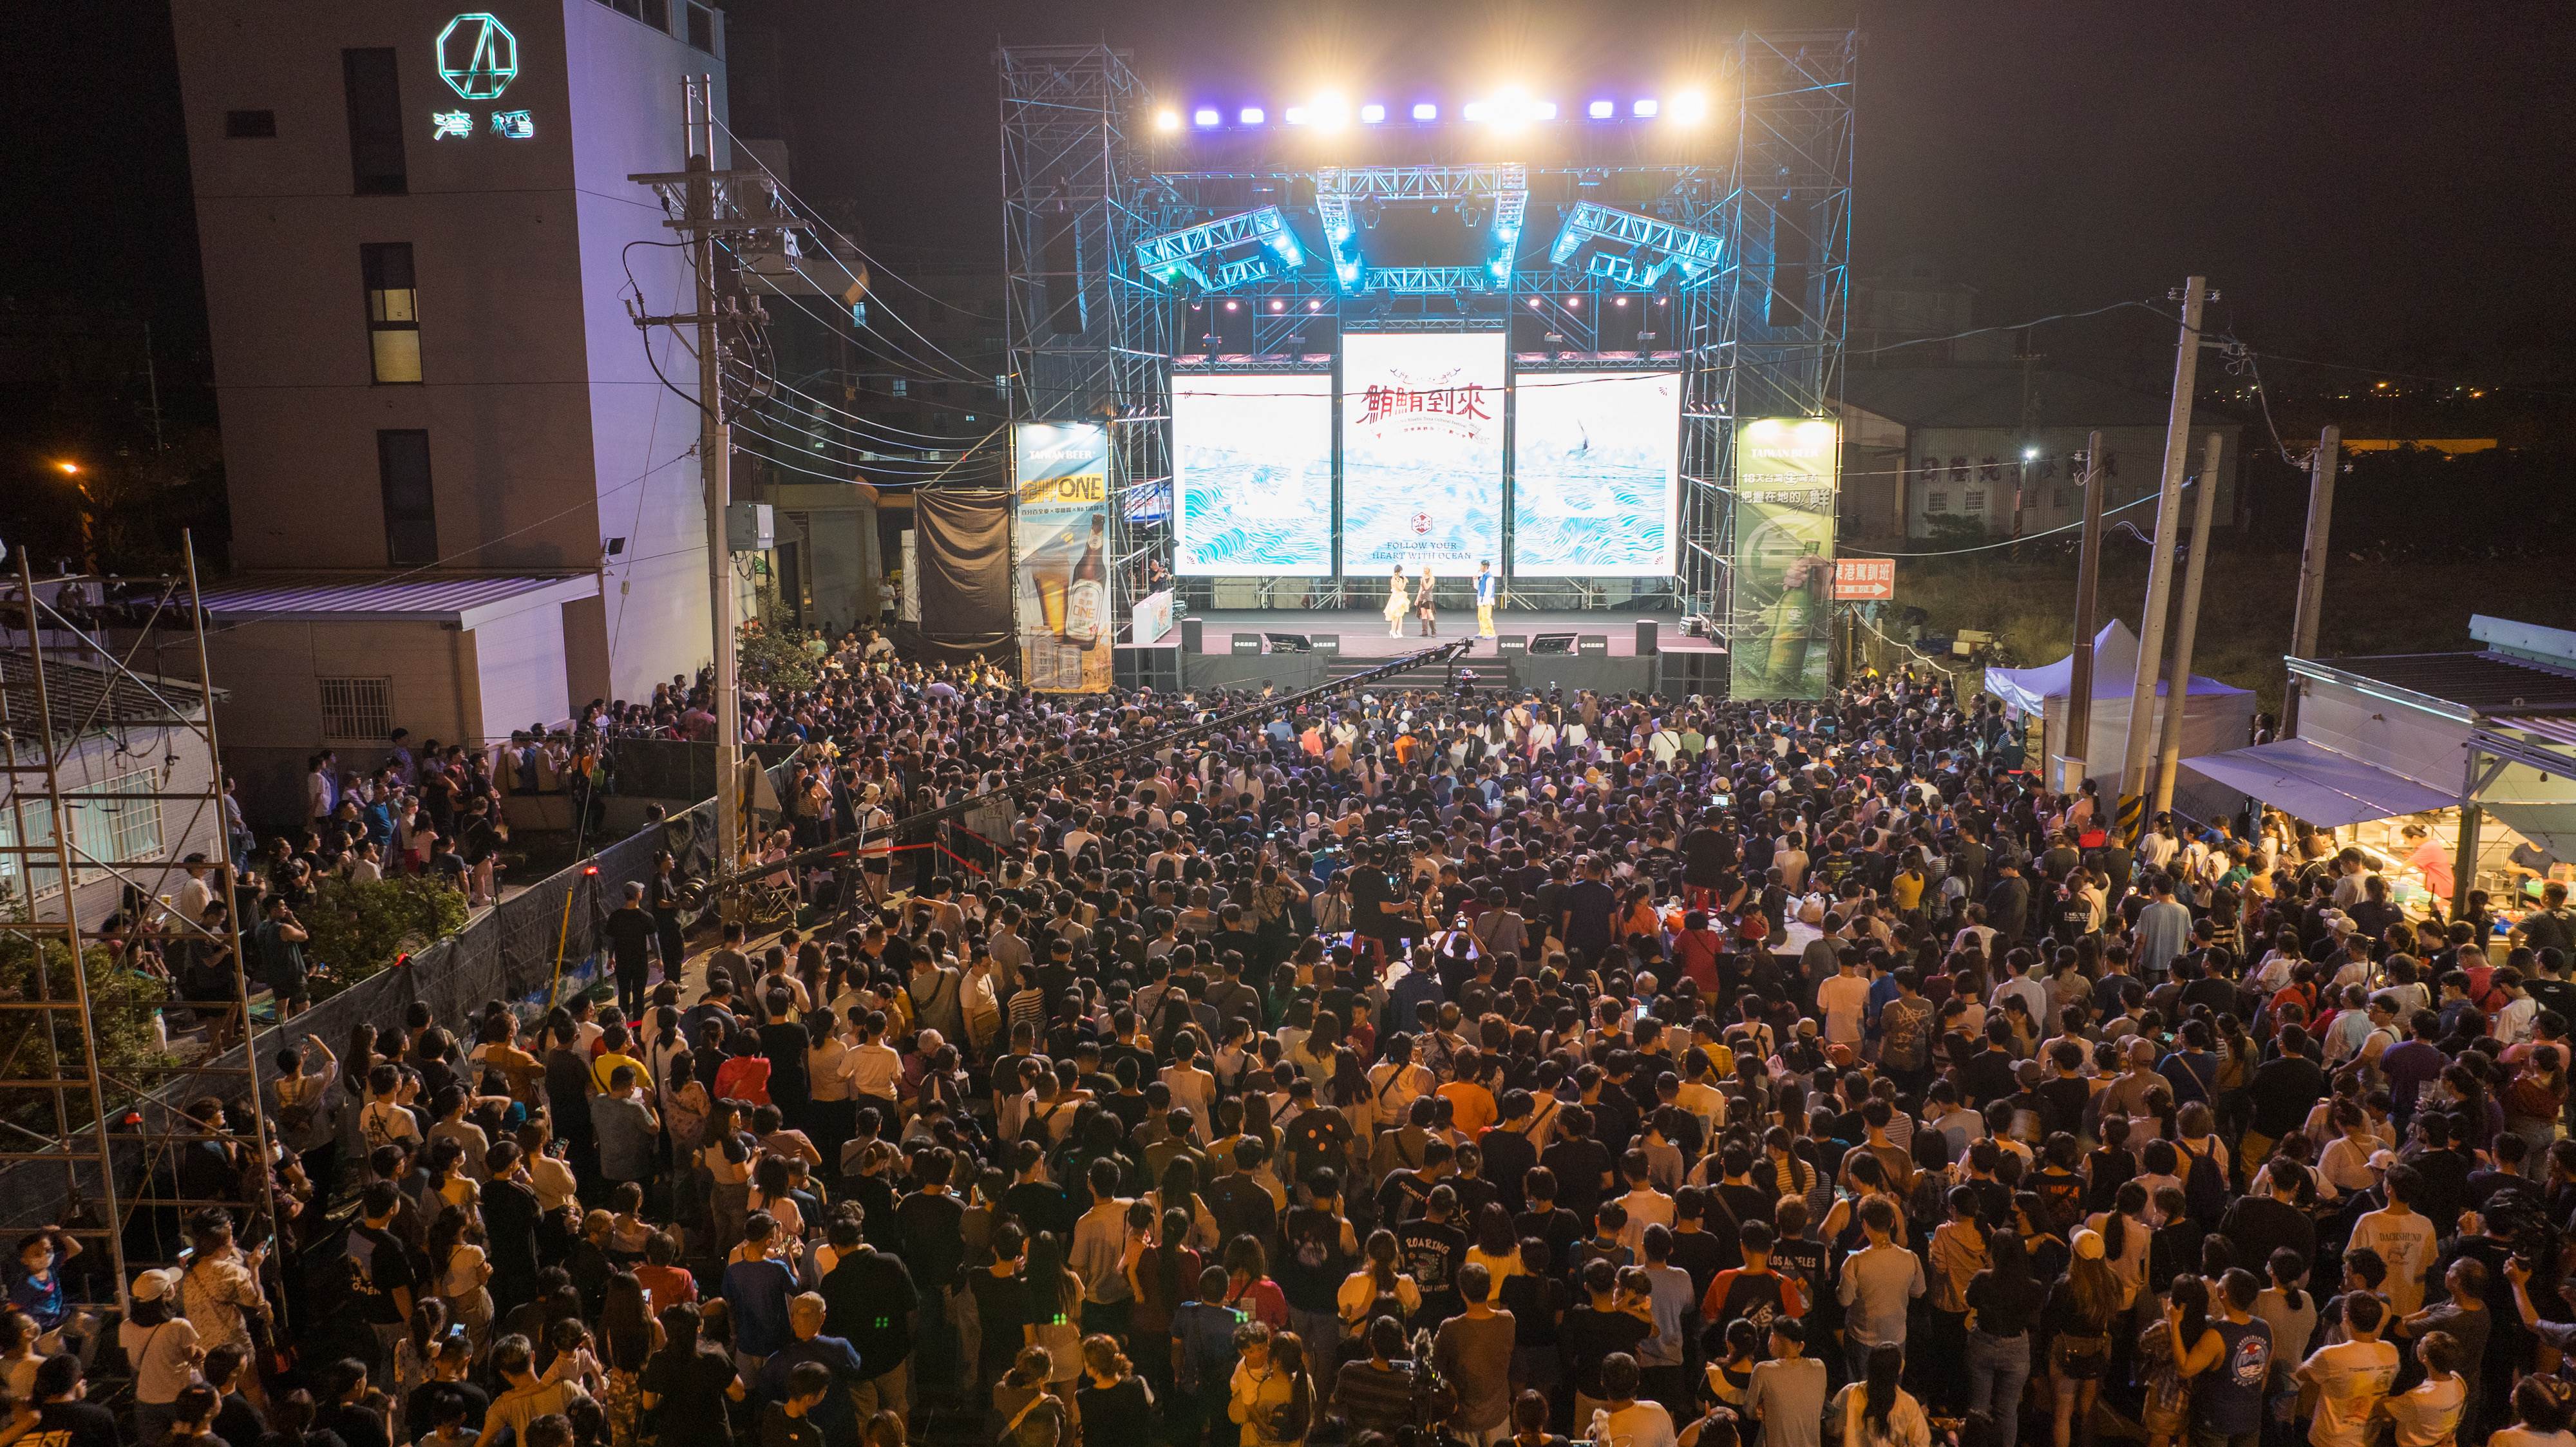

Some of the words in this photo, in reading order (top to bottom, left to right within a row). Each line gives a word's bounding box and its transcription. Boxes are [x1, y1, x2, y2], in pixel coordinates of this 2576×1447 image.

[1356, 383, 1492, 424] 鮪鮪到來
[1029, 450, 1062, 459] TAIWAN
[1066, 450, 1092, 459] BEER
[1752, 448, 1790, 458] TAIWAN
[1835, 563, 1890, 581] 東港駕訓班
[2379, 1232, 2421, 1242] DACHSHUND
[1406, 1237, 1450, 1254] ROARING
[1768, 1255, 1783, 1267] LOS
